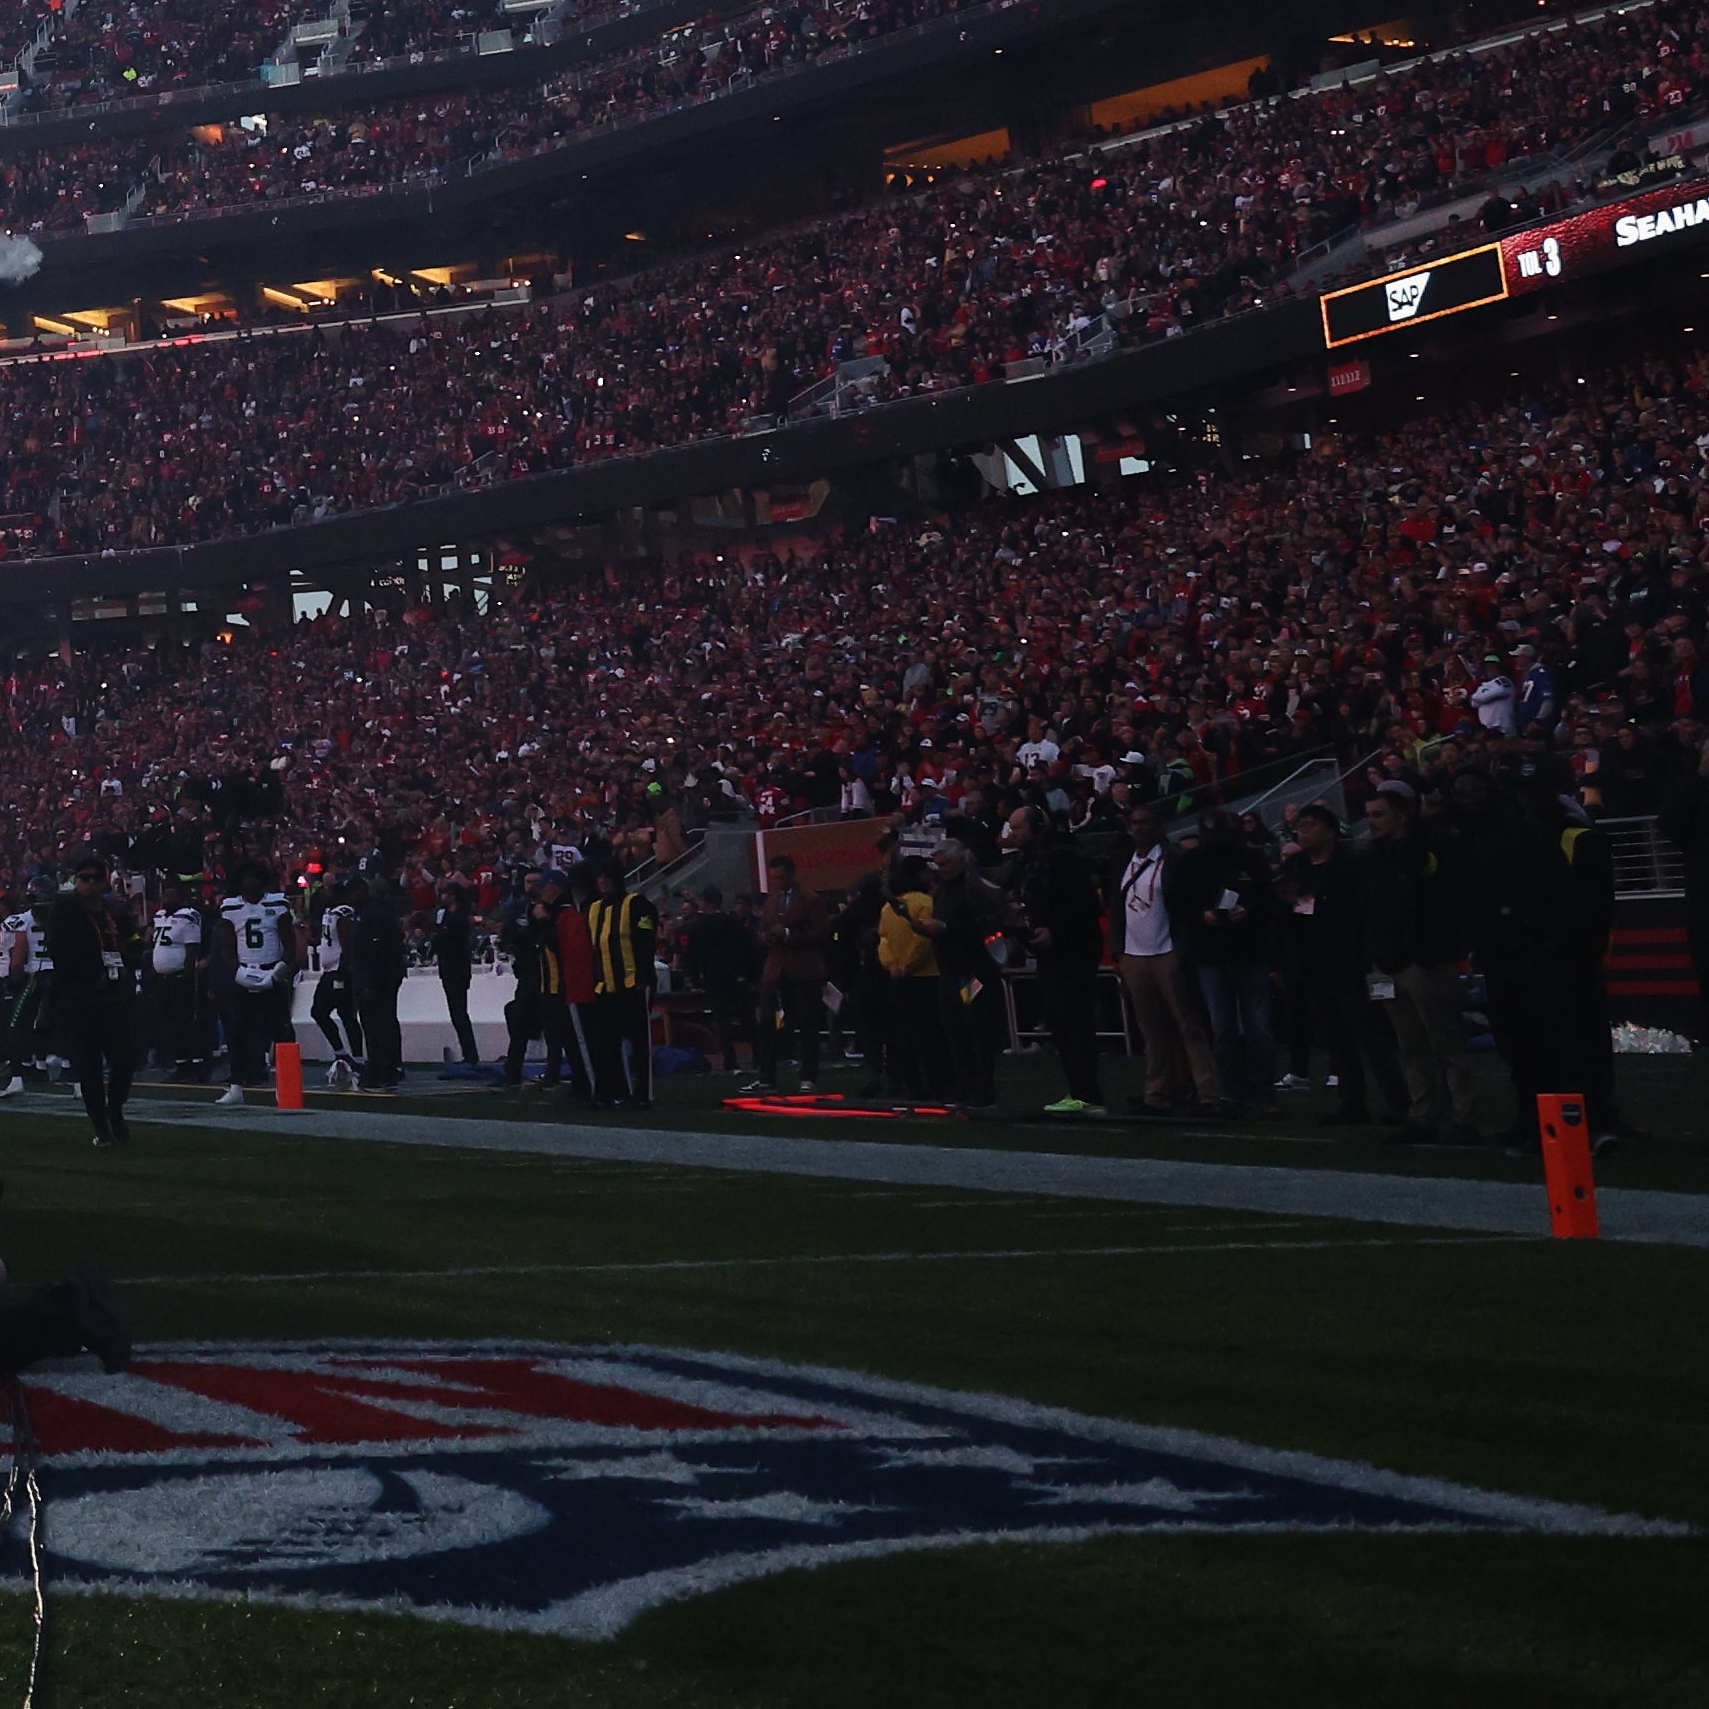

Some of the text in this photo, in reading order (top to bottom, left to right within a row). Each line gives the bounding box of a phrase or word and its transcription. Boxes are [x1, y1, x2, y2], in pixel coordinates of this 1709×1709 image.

[1518, 237, 1562, 278] TOL 3
[1389, 284, 1420, 312] SAP
[245, 918, 264, 949] 6
